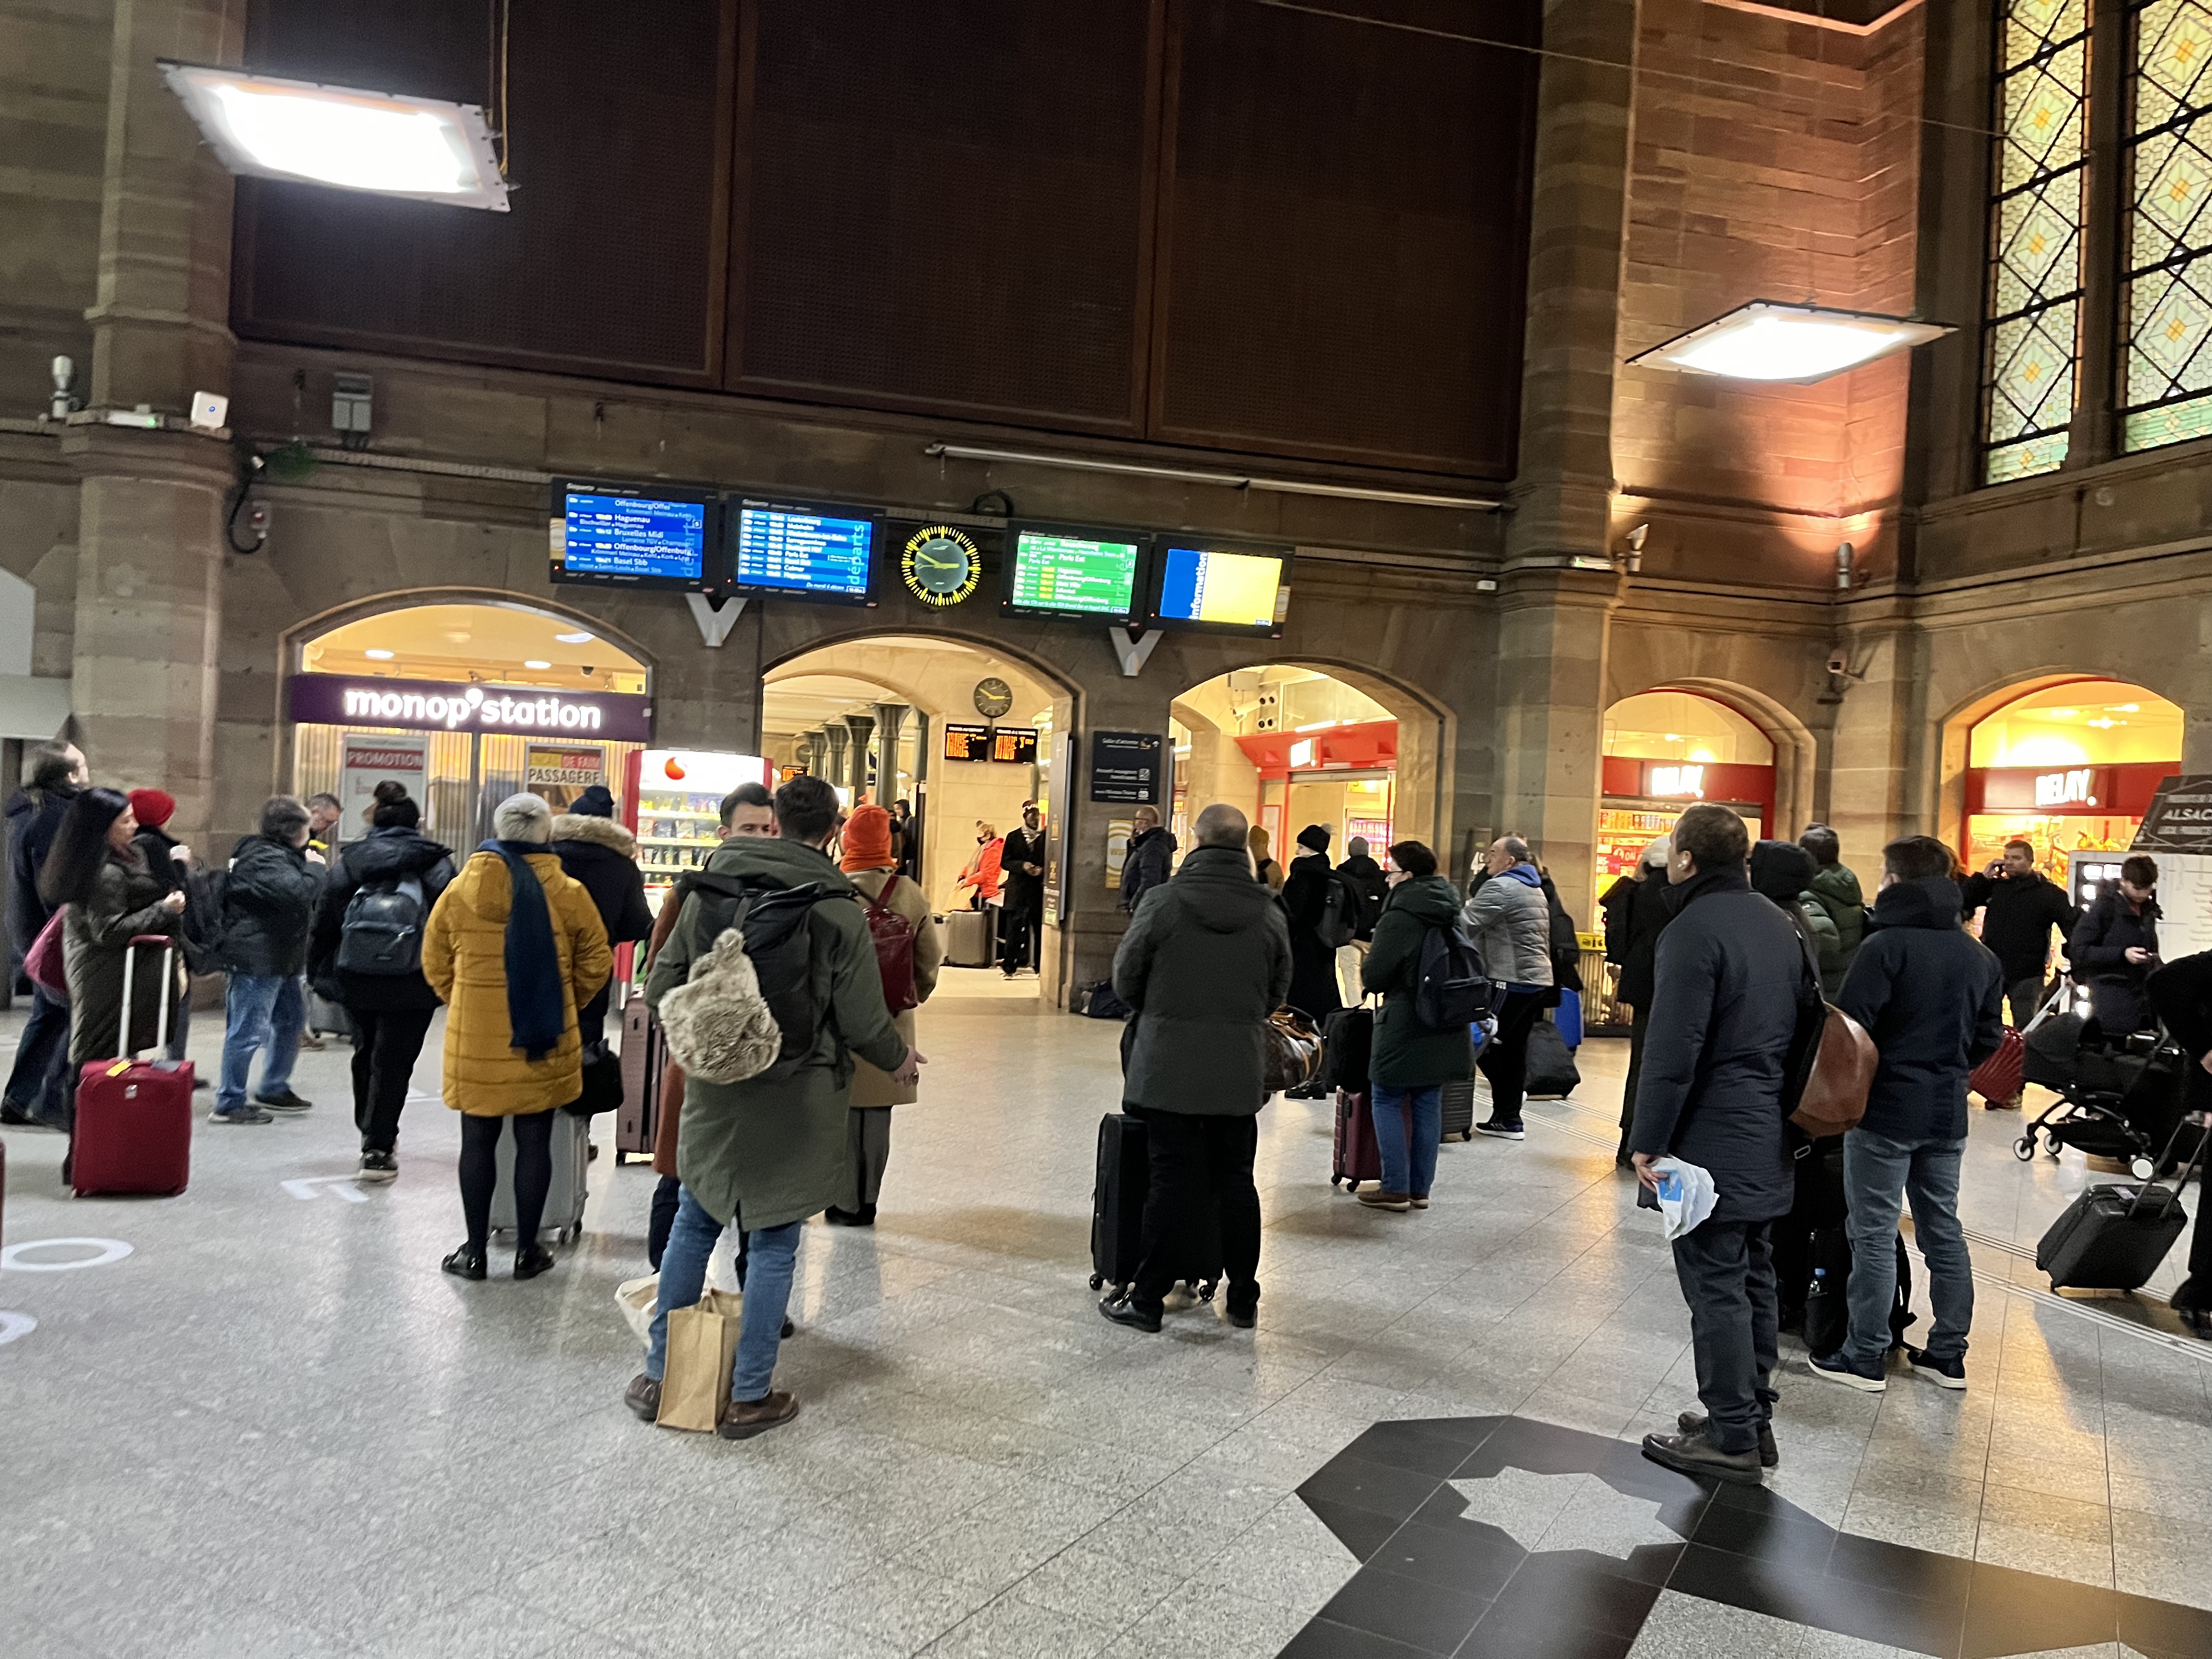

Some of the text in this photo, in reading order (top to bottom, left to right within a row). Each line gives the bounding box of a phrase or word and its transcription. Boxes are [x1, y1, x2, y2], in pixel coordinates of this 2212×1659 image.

[614, 514, 651, 523] Haguenau
[614, 528, 663, 538] Bruxelles Midi
[847, 524, 865, 585] départs
[1058, 554, 1074, 562] Paris
[613, 556, 648, 566] Basel Sbb
[345, 688, 601, 729] monop'station
